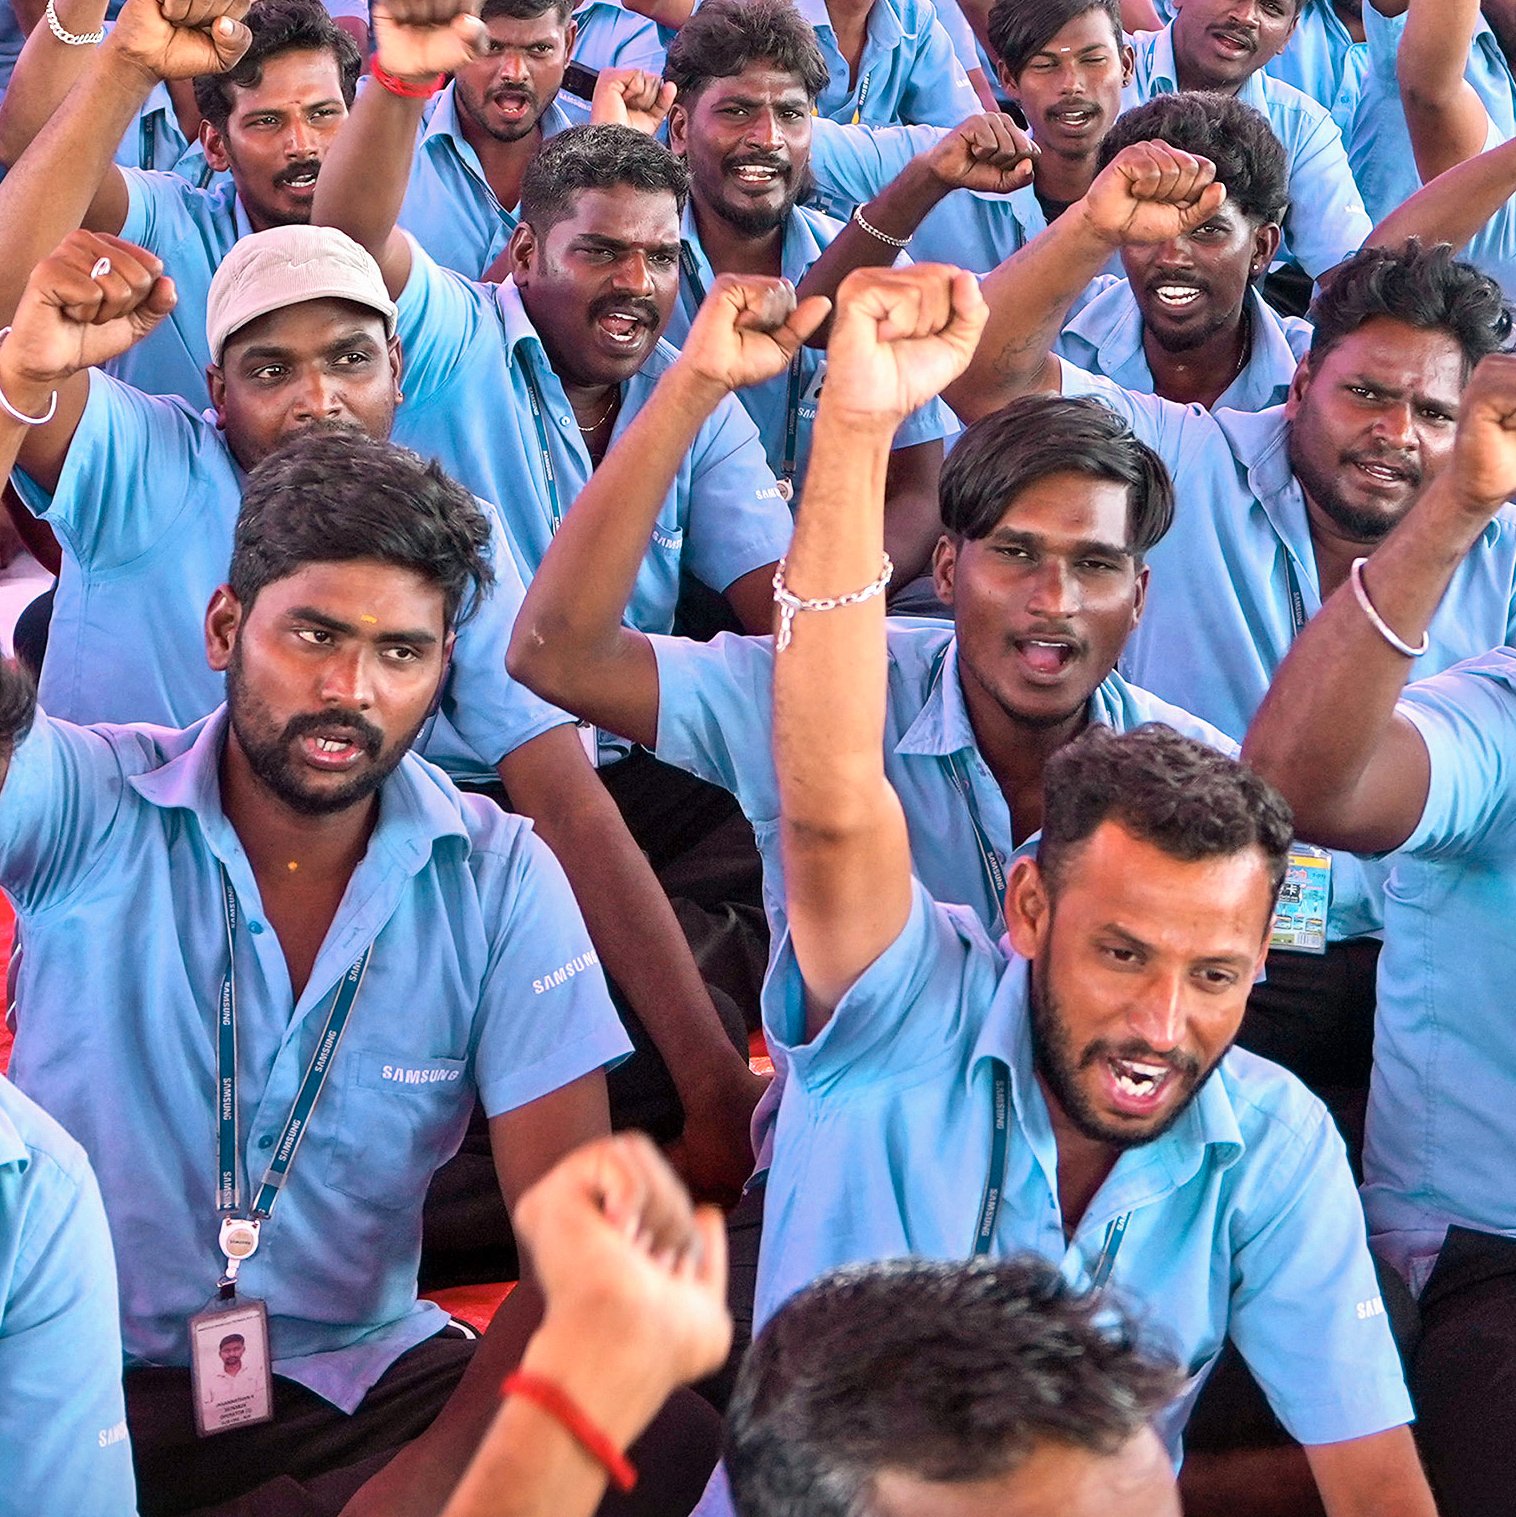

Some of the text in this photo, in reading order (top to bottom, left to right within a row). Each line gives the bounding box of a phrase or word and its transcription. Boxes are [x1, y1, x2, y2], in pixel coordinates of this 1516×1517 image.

[652, 530, 683, 551] SAMS
[222, 982, 232, 1026] SAMSUNG
[314, 1029, 338, 1074] SAMSUNG
[381, 1064, 460, 1085] SAMSUNG
[222, 1076, 232, 1121] SAMSUNG
[278, 1118, 302, 1162] SAMSUNG
